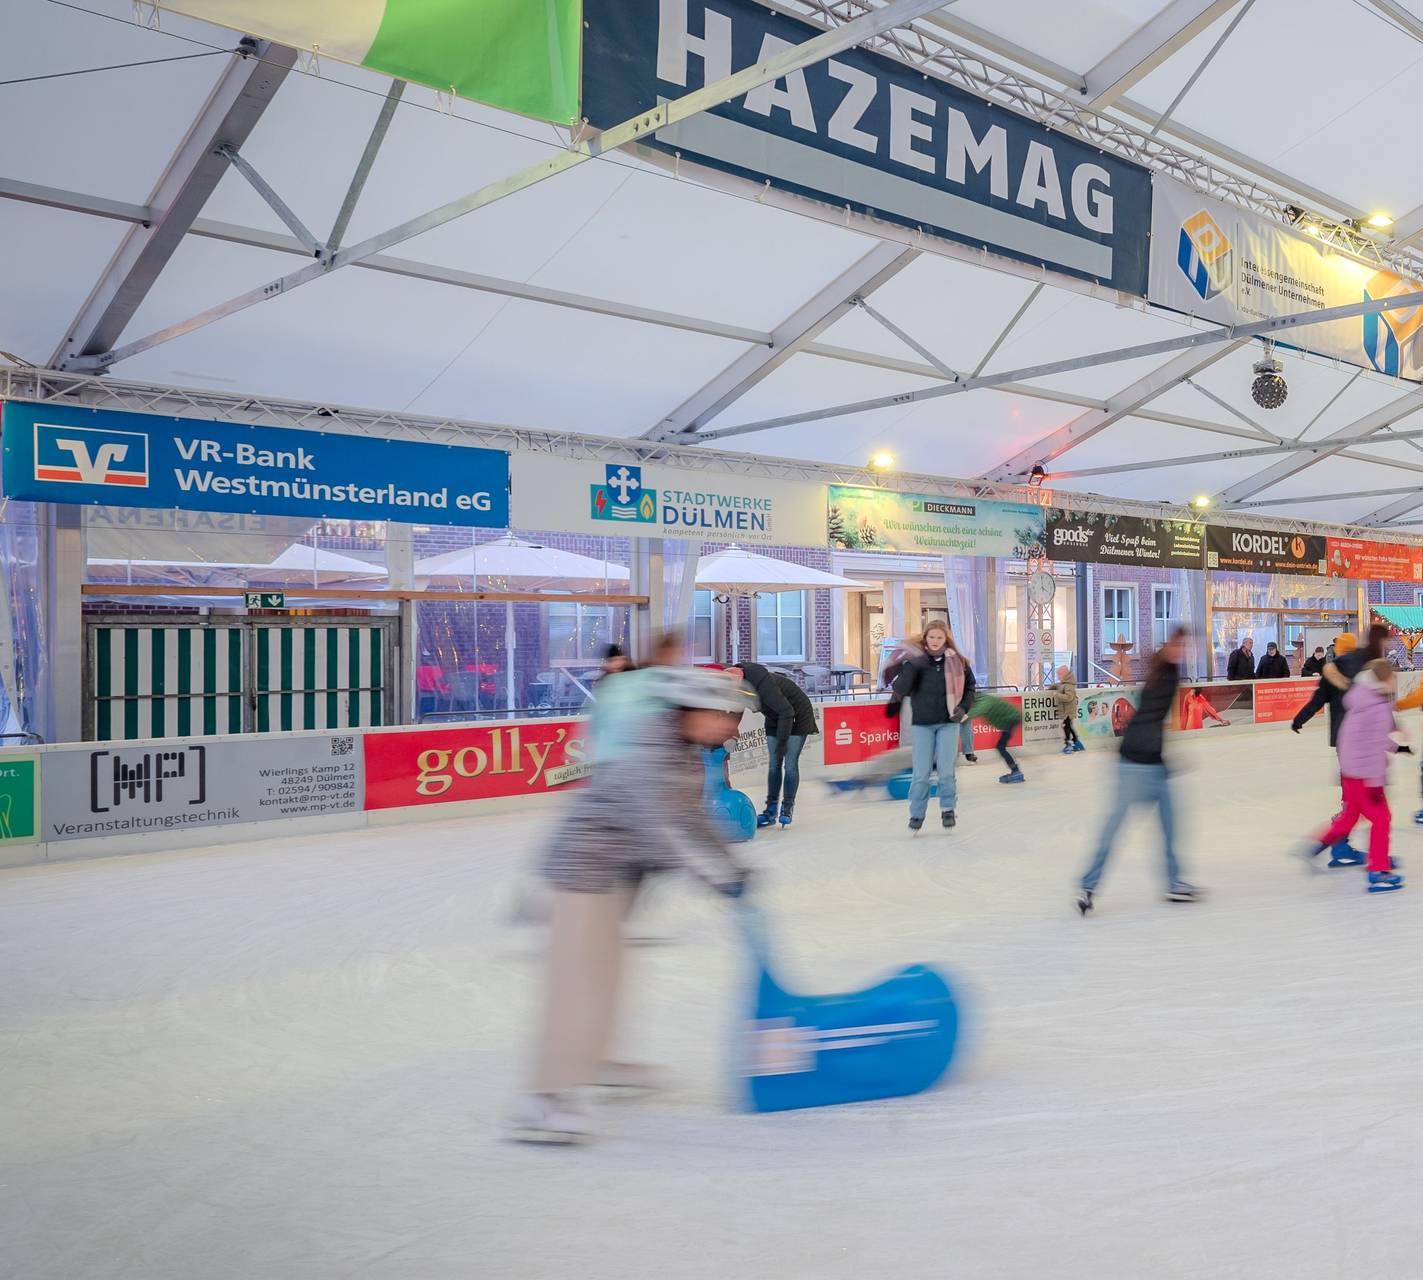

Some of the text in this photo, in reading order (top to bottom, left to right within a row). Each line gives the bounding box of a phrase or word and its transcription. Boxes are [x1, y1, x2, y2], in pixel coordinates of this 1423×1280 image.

[657, 0, 1114, 234] HAZEMAG
[1241, 257, 1325, 297] Interessengemeinschaft
[1241, 272, 1326, 310] Dülmener Unternehmen
[173, 437, 316, 471] VR-Bank
[175, 468, 491, 511] Westmünsterland eG
[663, 489, 772, 511] STADTWERKE
[927, 503, 973, 515] DIECKMANN
[663, 505, 766, 531] DÜLMEN
[663, 527, 704, 537] kompetent
[707, 530, 746, 540] persönlich
[884, 519, 901, 530] Wir
[902, 521, 942, 533] wünschen
[977, 526, 1003, 538] schöne
[1053, 526, 1089, 546] goods
[1104, 532, 1157, 548] Viel Spaß beim
[1099, 544, 1134, 558] Dülmener
[1135, 546, 1161, 559] Winter!
[1024, 711, 1032, 722] &
[1024, 723, 1033, 731] das
[1034, 724, 1048, 733] ganze
[859, 728, 901, 748] Sparka
[0, 768, 20, 778] rt.
[259, 763, 355, 779] Wierlings Kamp 12
[280, 772, 355, 786] 48249 Dülmen
[553, 765, 582, 781] täglich
[259, 789, 355, 807] kontakt@mp-vt.de
[266, 787, 275, 796] T:
[280, 800, 355, 815] www.mp-vt.de
[53, 807, 240, 837] Veranstaltungstechnik
